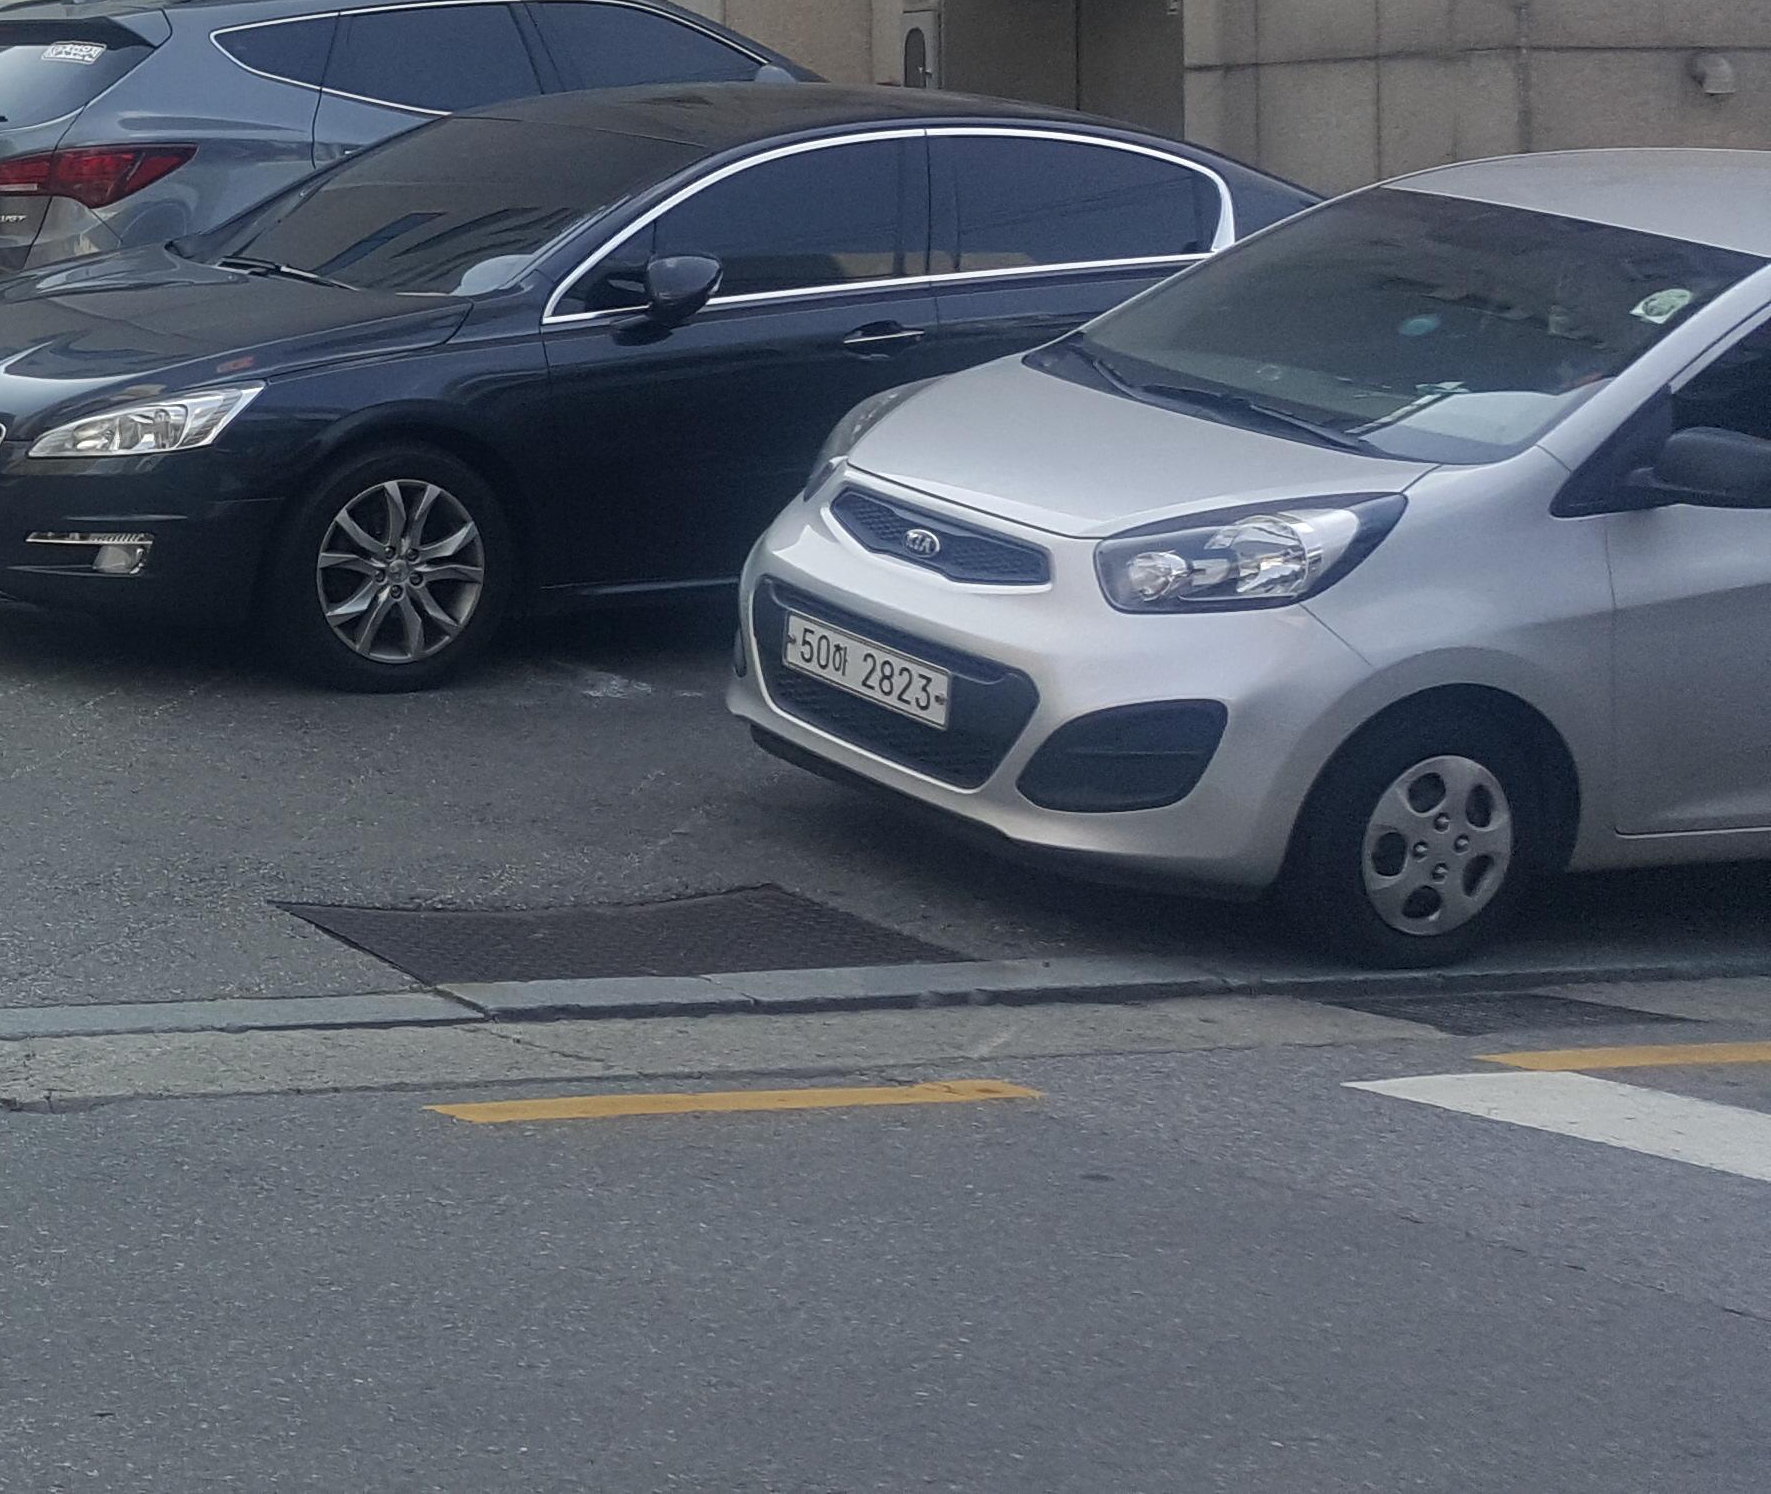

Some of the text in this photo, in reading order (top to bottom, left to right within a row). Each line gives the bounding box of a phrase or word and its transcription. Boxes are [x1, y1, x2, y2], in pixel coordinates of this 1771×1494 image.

[906, 530, 933, 555] KIA
[799, 627, 933, 712] 50하 2823
